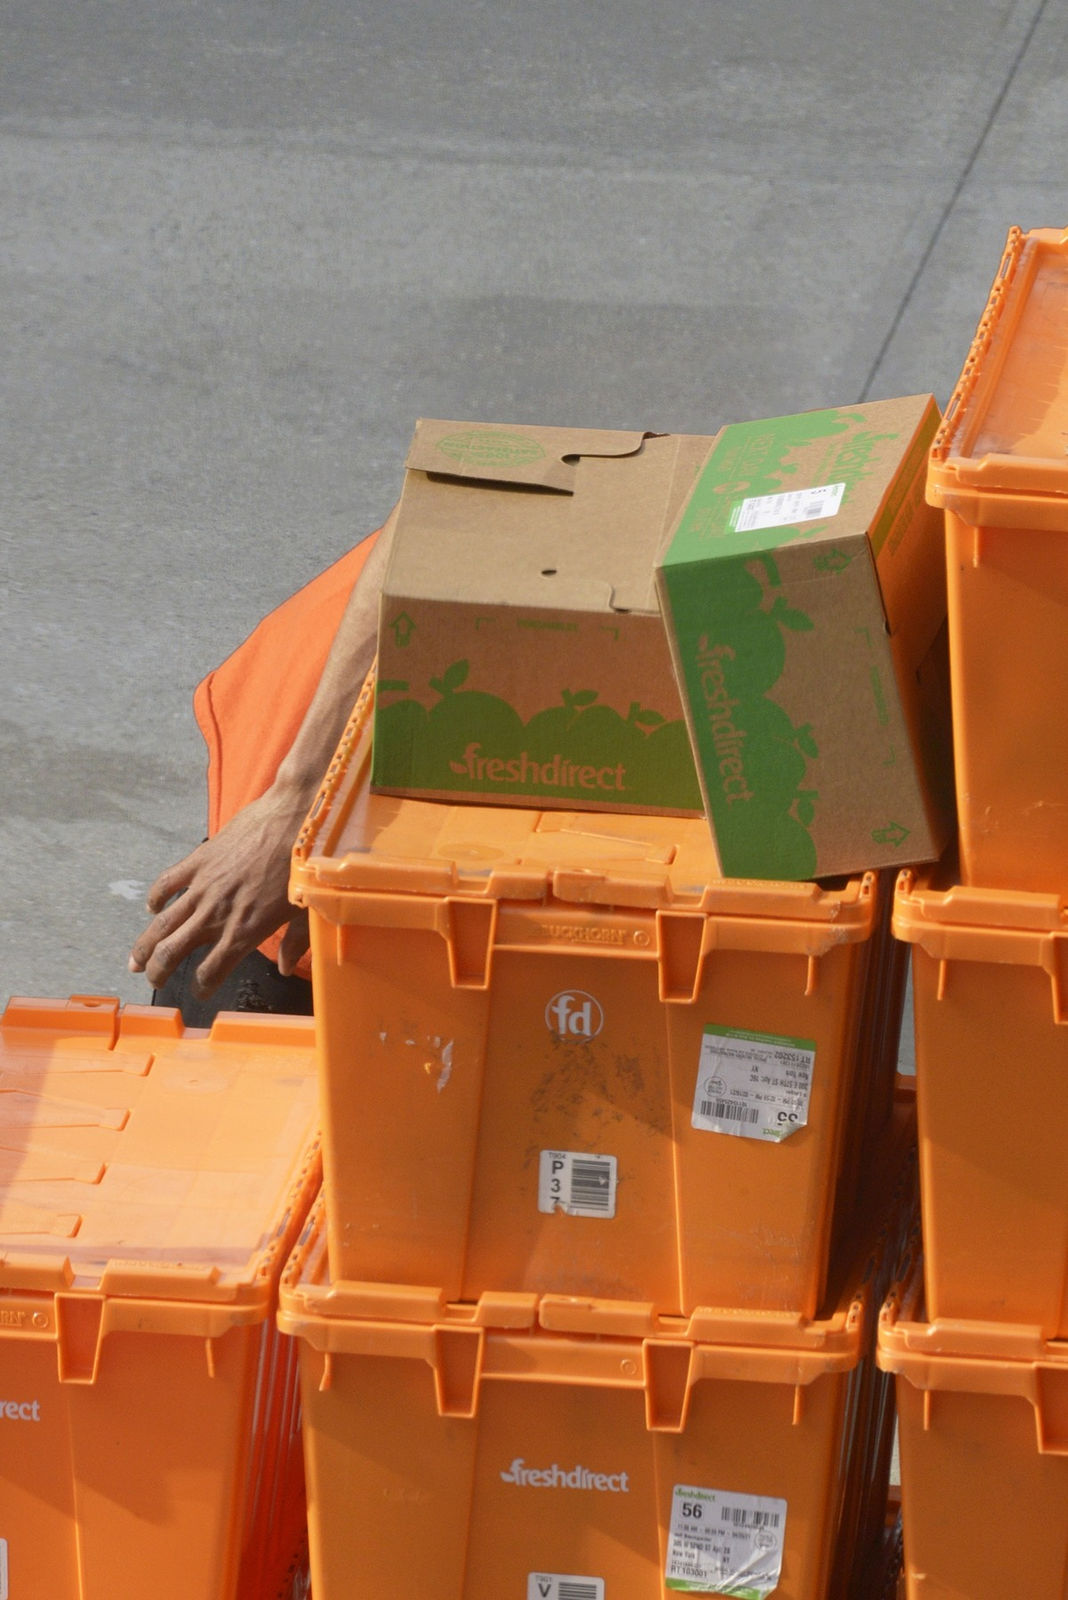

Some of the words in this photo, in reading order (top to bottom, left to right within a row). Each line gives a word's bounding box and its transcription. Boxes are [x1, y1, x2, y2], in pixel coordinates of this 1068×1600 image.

[697, 640, 754, 806] freshdirect
[460, 742, 627, 791] freshdirect
[552, 995, 591, 1037] fd
[505, 1457, 630, 1493] freshdirect
[682, 1502, 703, 1520] 56
